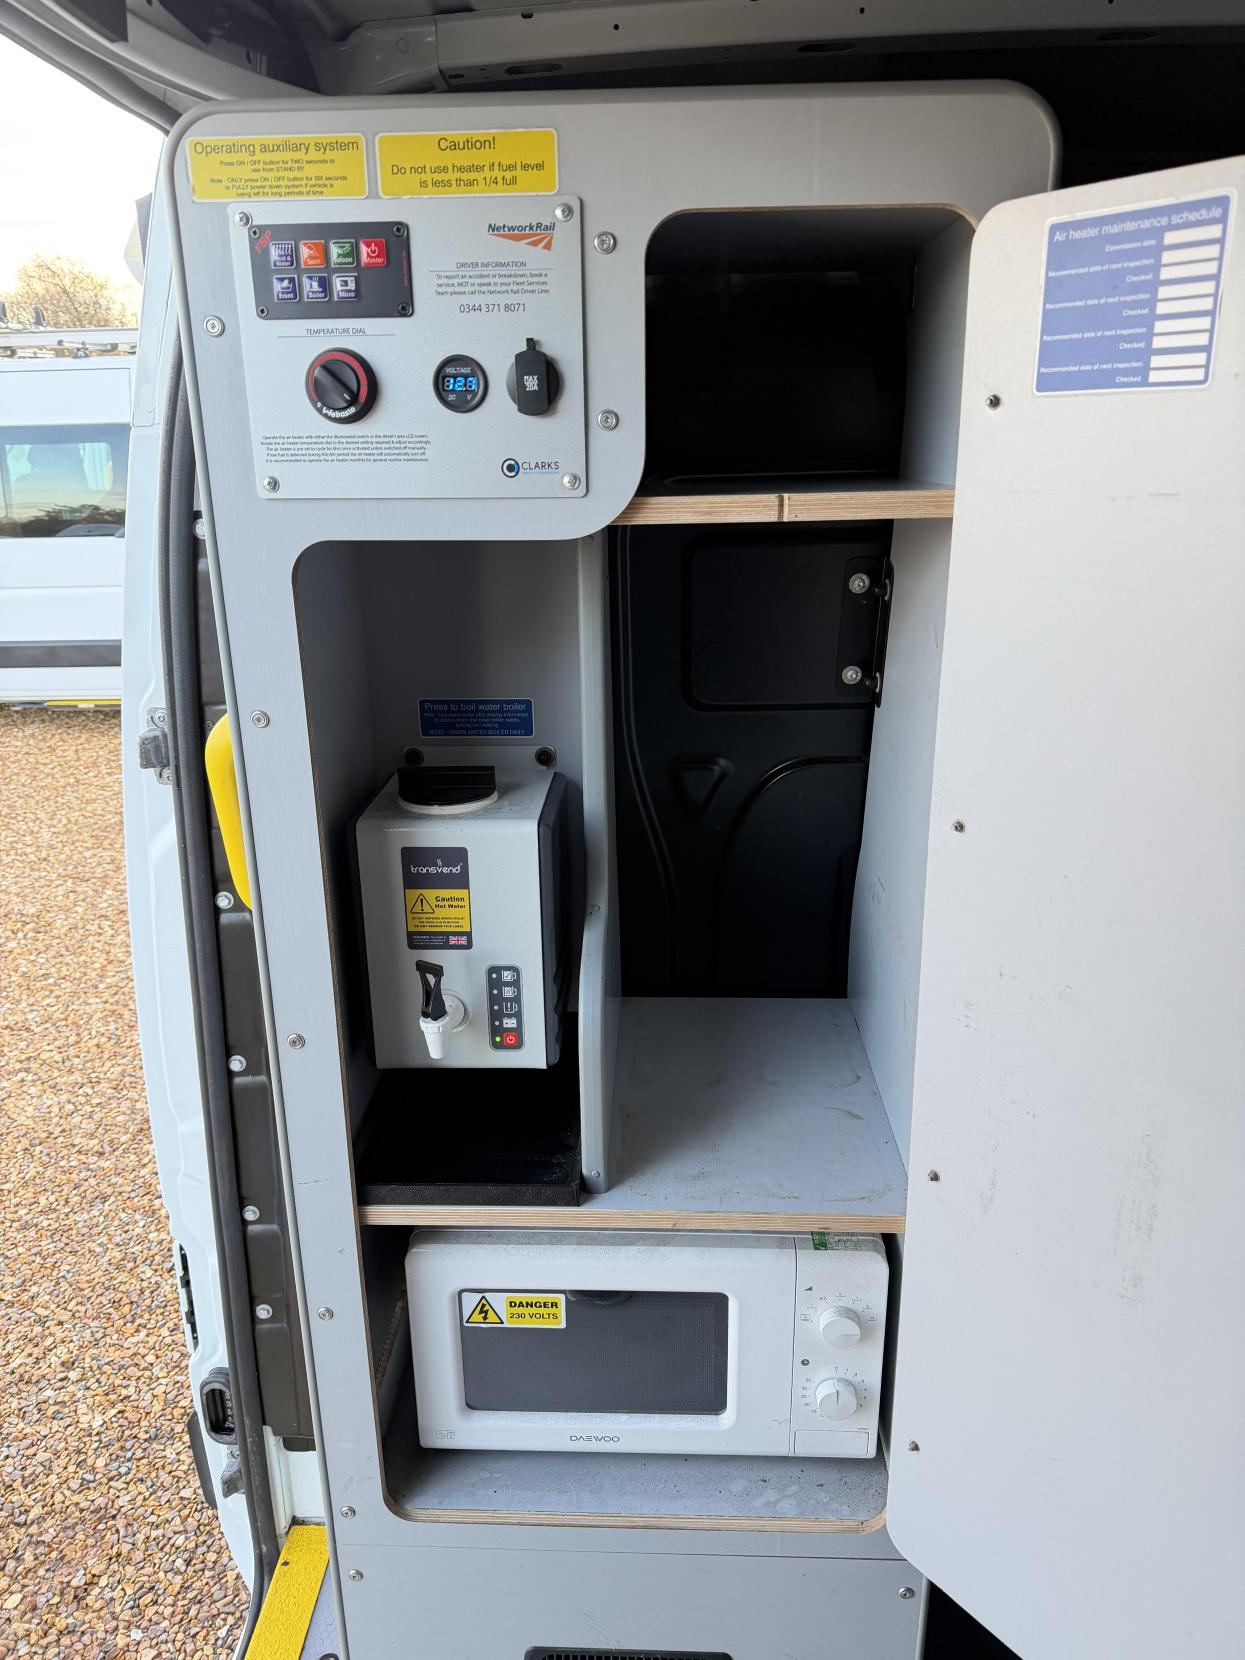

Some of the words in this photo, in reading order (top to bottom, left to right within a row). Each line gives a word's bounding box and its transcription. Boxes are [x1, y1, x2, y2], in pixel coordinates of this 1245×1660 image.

[194, 141, 256, 157] Operating
[259, 140, 310, 155] auxiliary
[314, 140, 359, 155] system
[437, 136, 496, 152] Caution!
[391, 164, 407, 175] Do
[409, 164, 426, 175] not
[430, 165, 449, 174] use
[452, 163, 486, 173] heater
[489, 162, 496, 172] if
[497, 161, 517, 172] fuel
[520, 160, 545, 171] level
[419, 178, 429, 188] is
[431, 177, 453, 188] less
[455, 176, 479, 187] than
[483, 176, 499, 188] 1/4
[501, 175, 517, 186] full
[487, 222, 556, 233] NetworkRail
[1053, 231, 1068, 242] Air
[1069, 227, 1099, 240] heater
[1101, 217, 1169, 235] maintenance
[1170, 205, 1223, 225] schedule
[480, 261, 527, 269] INFORMATION
[1125, 273, 1153, 283] Checked
[459, 303, 482, 313] 0344
[485, 303, 501, 313] 371
[504, 303, 526, 313] 8071
[1122, 308, 1149, 316] Checked
[305, 328, 351, 336] TEMPERATURE
[1119, 341, 1145, 349] Checked
[523, 375, 538, 384] MAX
[525, 383, 538, 391] 20A
[521, 461, 560, 471] CLARKS
[425, 702, 448, 711] Press
[450, 703, 459, 711] to
[460, 702, 476, 711] boil
[478, 703, 502, 711] water
[503, 702, 527, 711] boiler
[410, 864, 460, 874] transvend
[509, 1301, 558, 1309] DANGER
[528, 1312, 558, 1320] VOLTS
